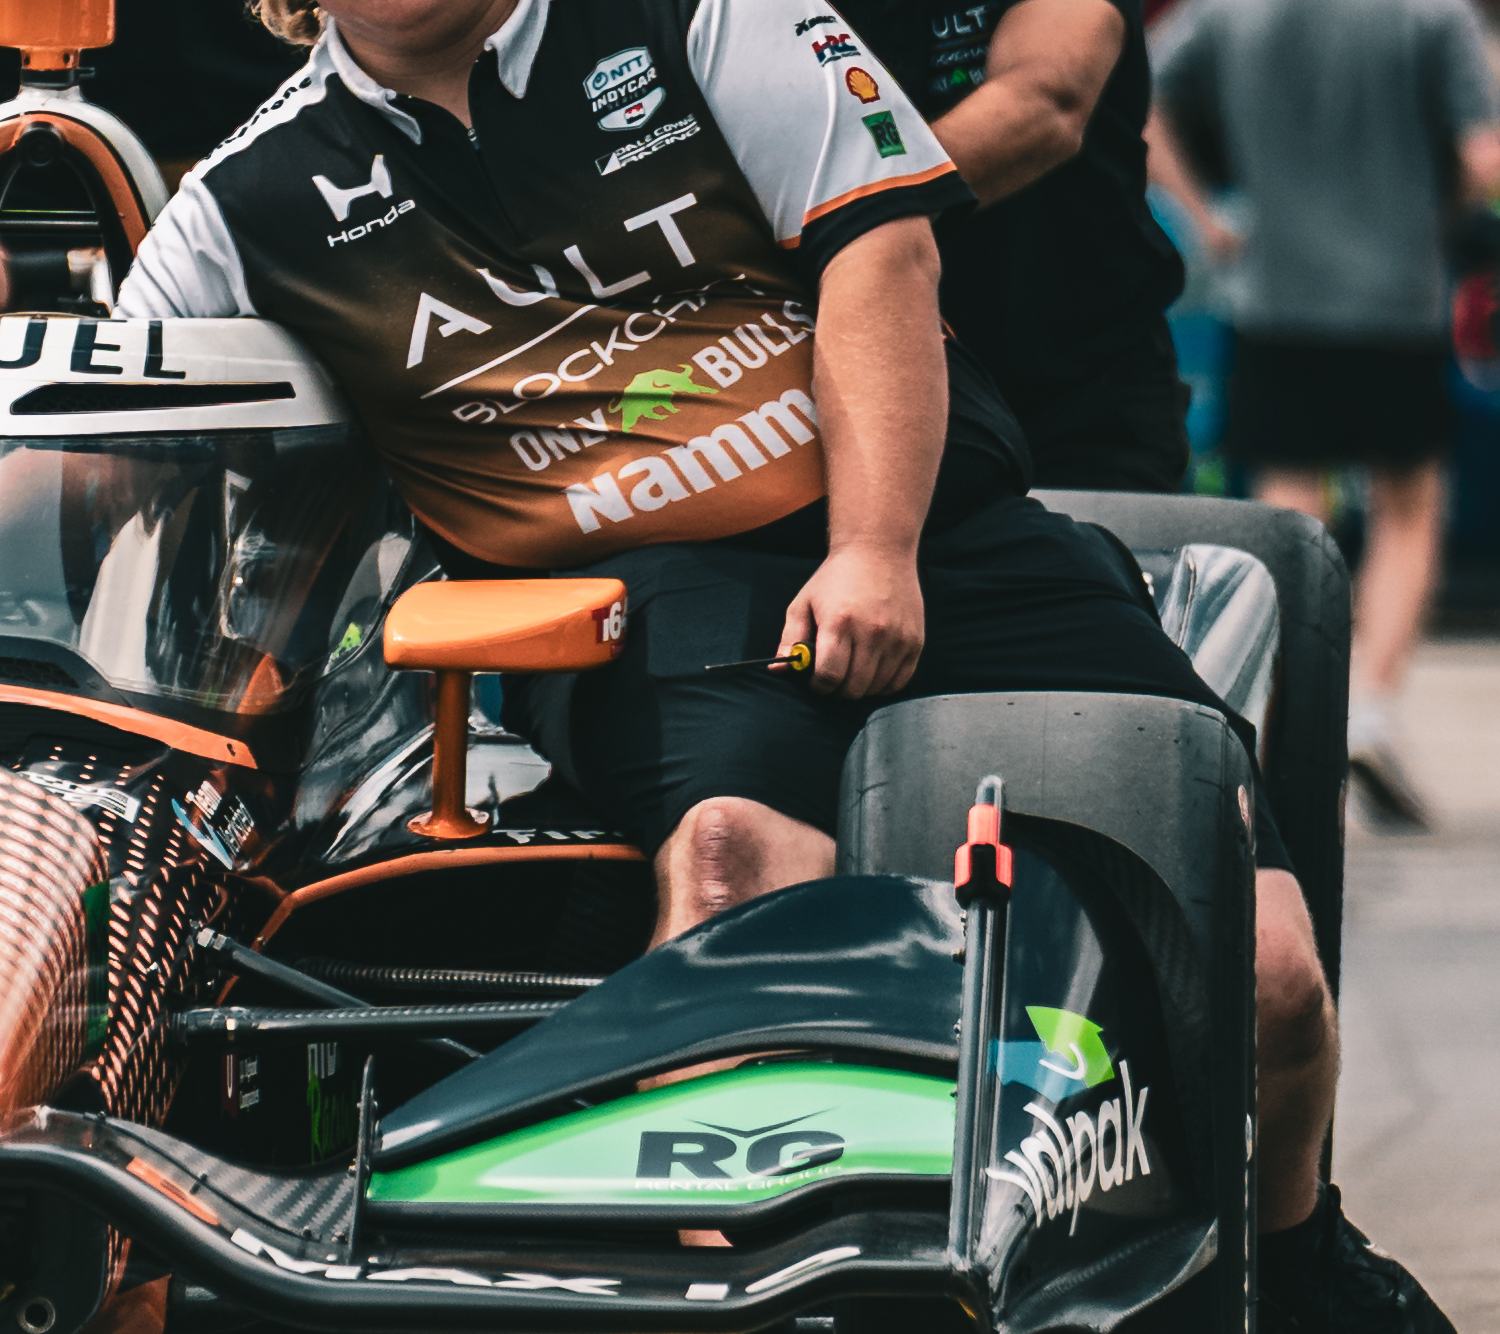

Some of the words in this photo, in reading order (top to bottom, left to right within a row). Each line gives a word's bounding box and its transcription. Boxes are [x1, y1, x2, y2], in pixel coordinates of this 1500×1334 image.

[931, 5, 986, 38] ULT
[591, 66, 657, 112] INDYCAR
[609, 54, 644, 81] NTT
[614, 133, 653, 156] DALE
[870, 121, 900, 148] RG
[327, 199, 416, 247] Honda
[406, 192, 698, 369] AULT
[452, 273, 765, 425] BLOCKC
[509, 407, 611, 472] ONLY
[691, 300, 817, 389] BULLS
[635, 1129, 846, 1178] RG
